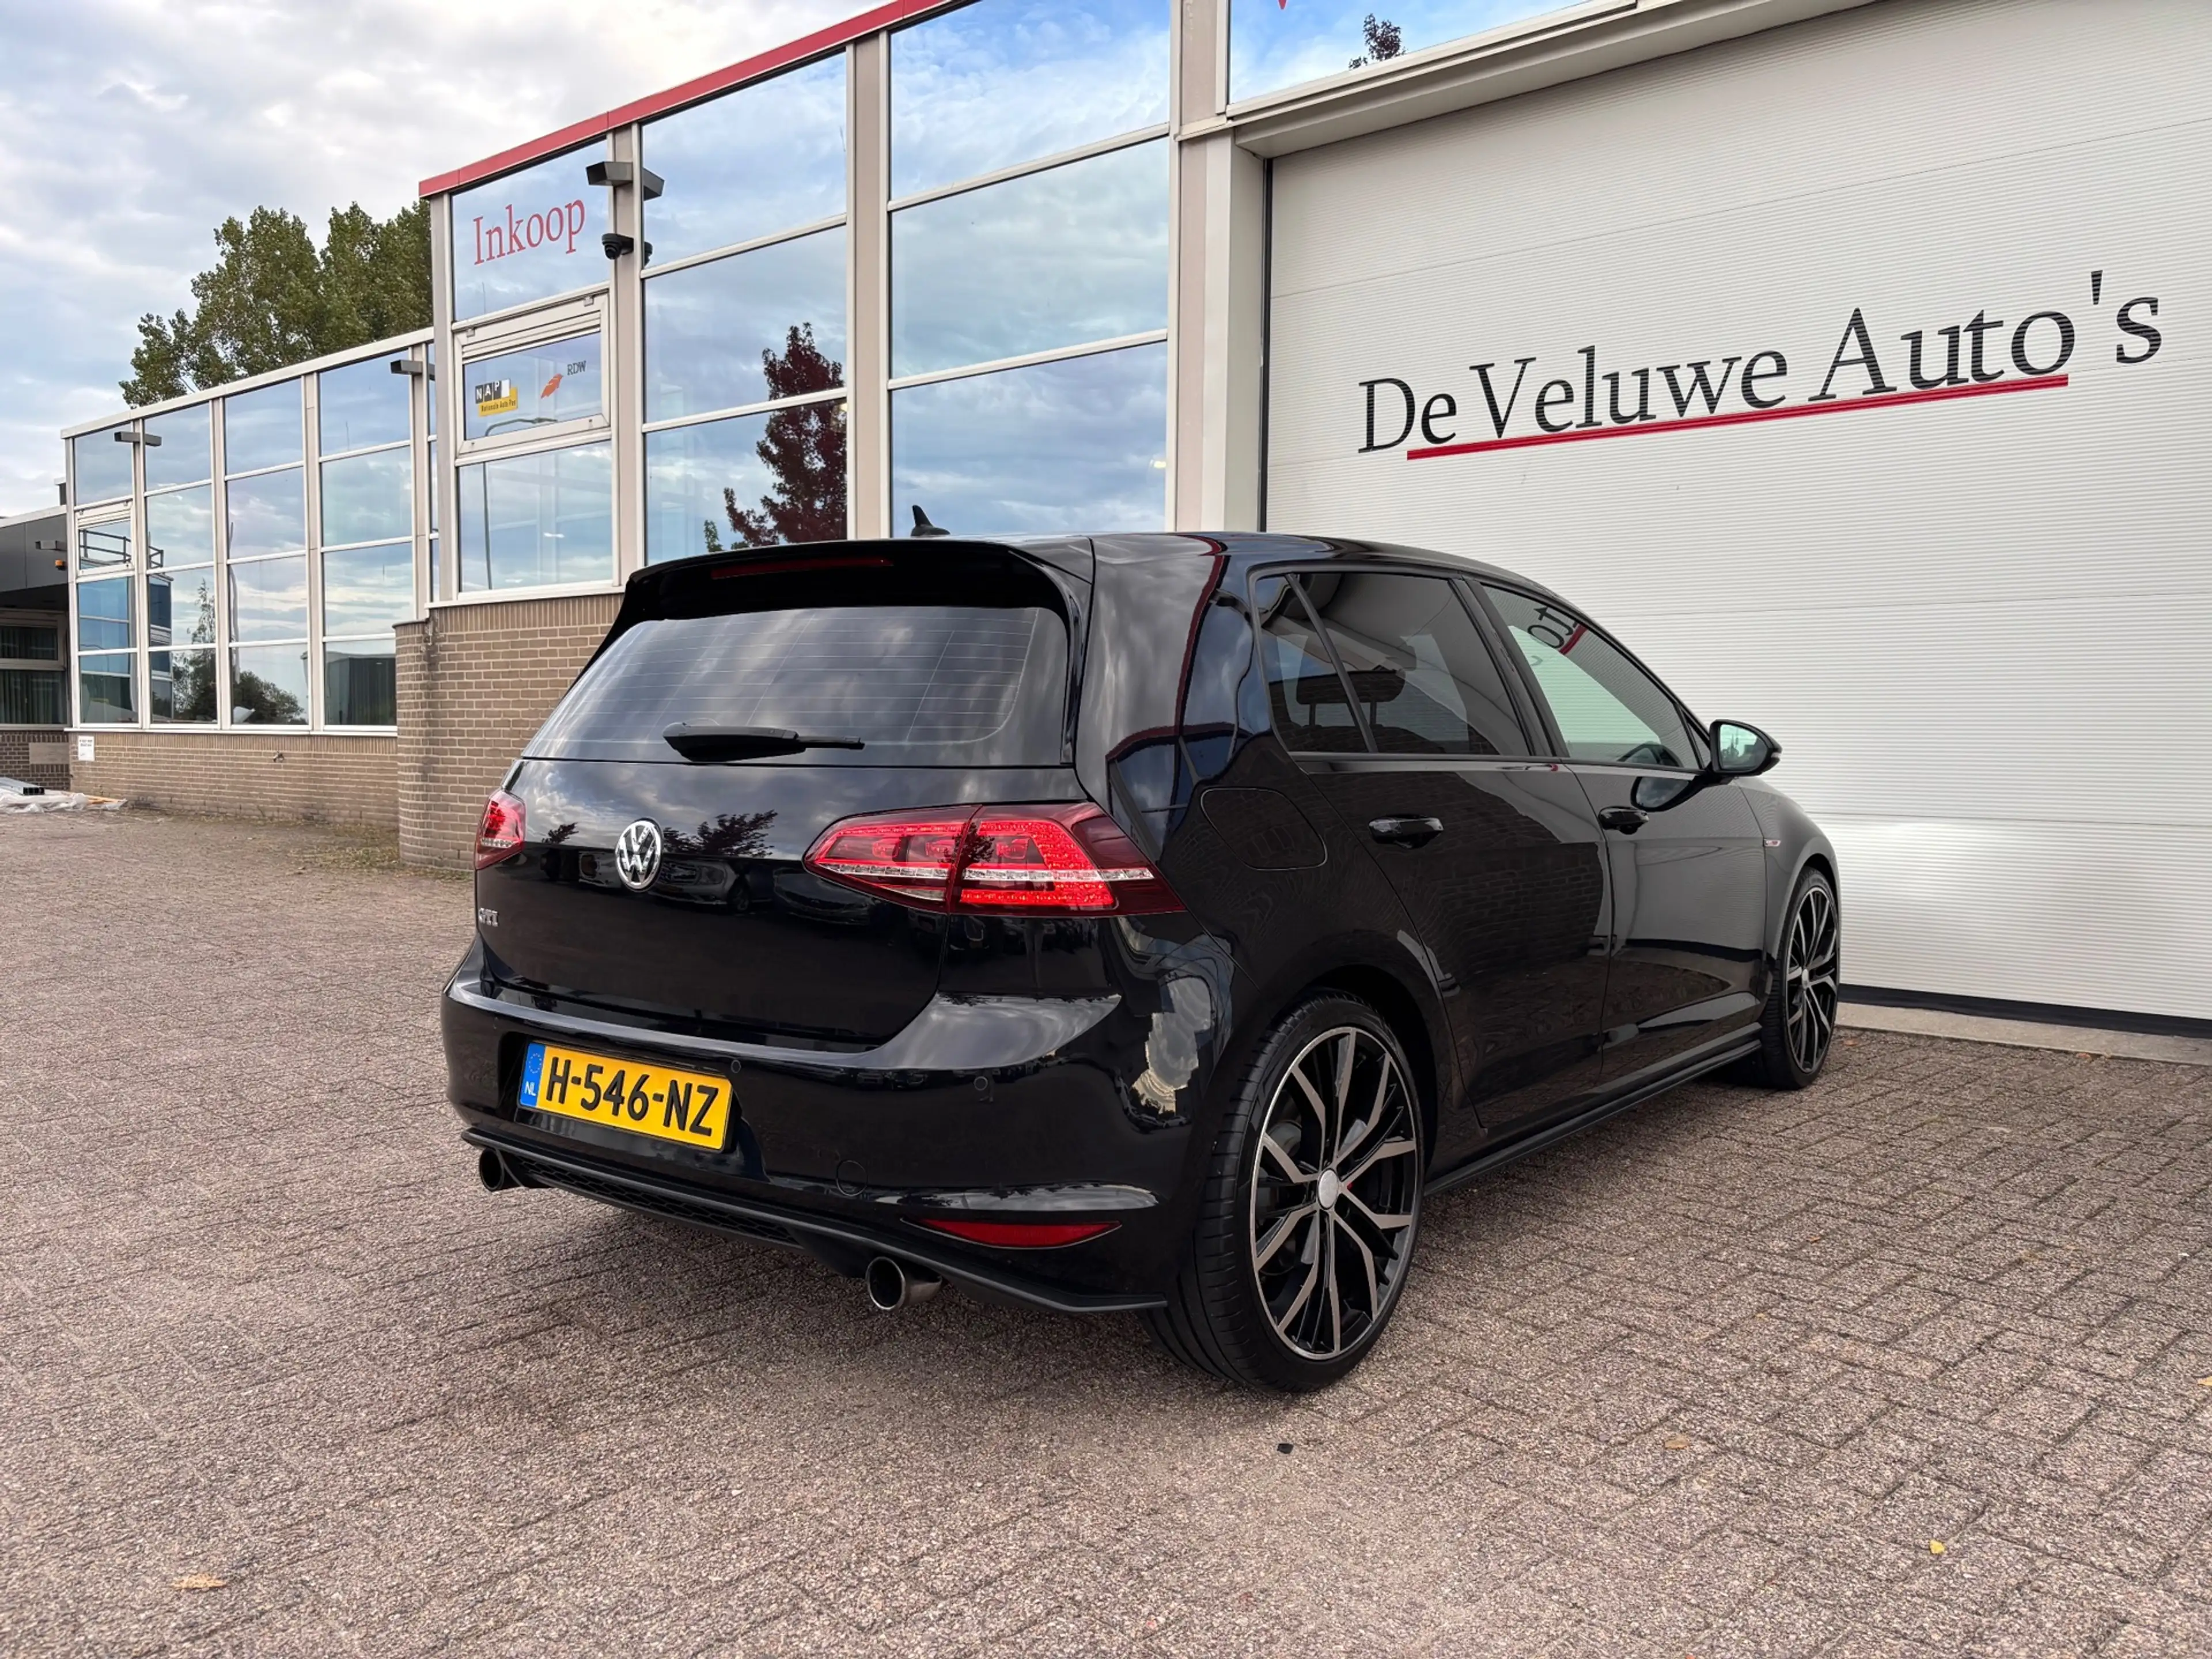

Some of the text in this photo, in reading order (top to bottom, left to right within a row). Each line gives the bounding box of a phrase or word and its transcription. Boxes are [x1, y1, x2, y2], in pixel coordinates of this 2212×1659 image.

[473, 199, 585, 265] Inkoop
[567, 360, 586, 376] RDW
[1358, 270, 2162, 453] De Veluwe Auto's
[476, 380, 500, 400] NAP
[479, 907, 499, 927] GTI
[525, 1056, 719, 1137] NL H-546-NZ
